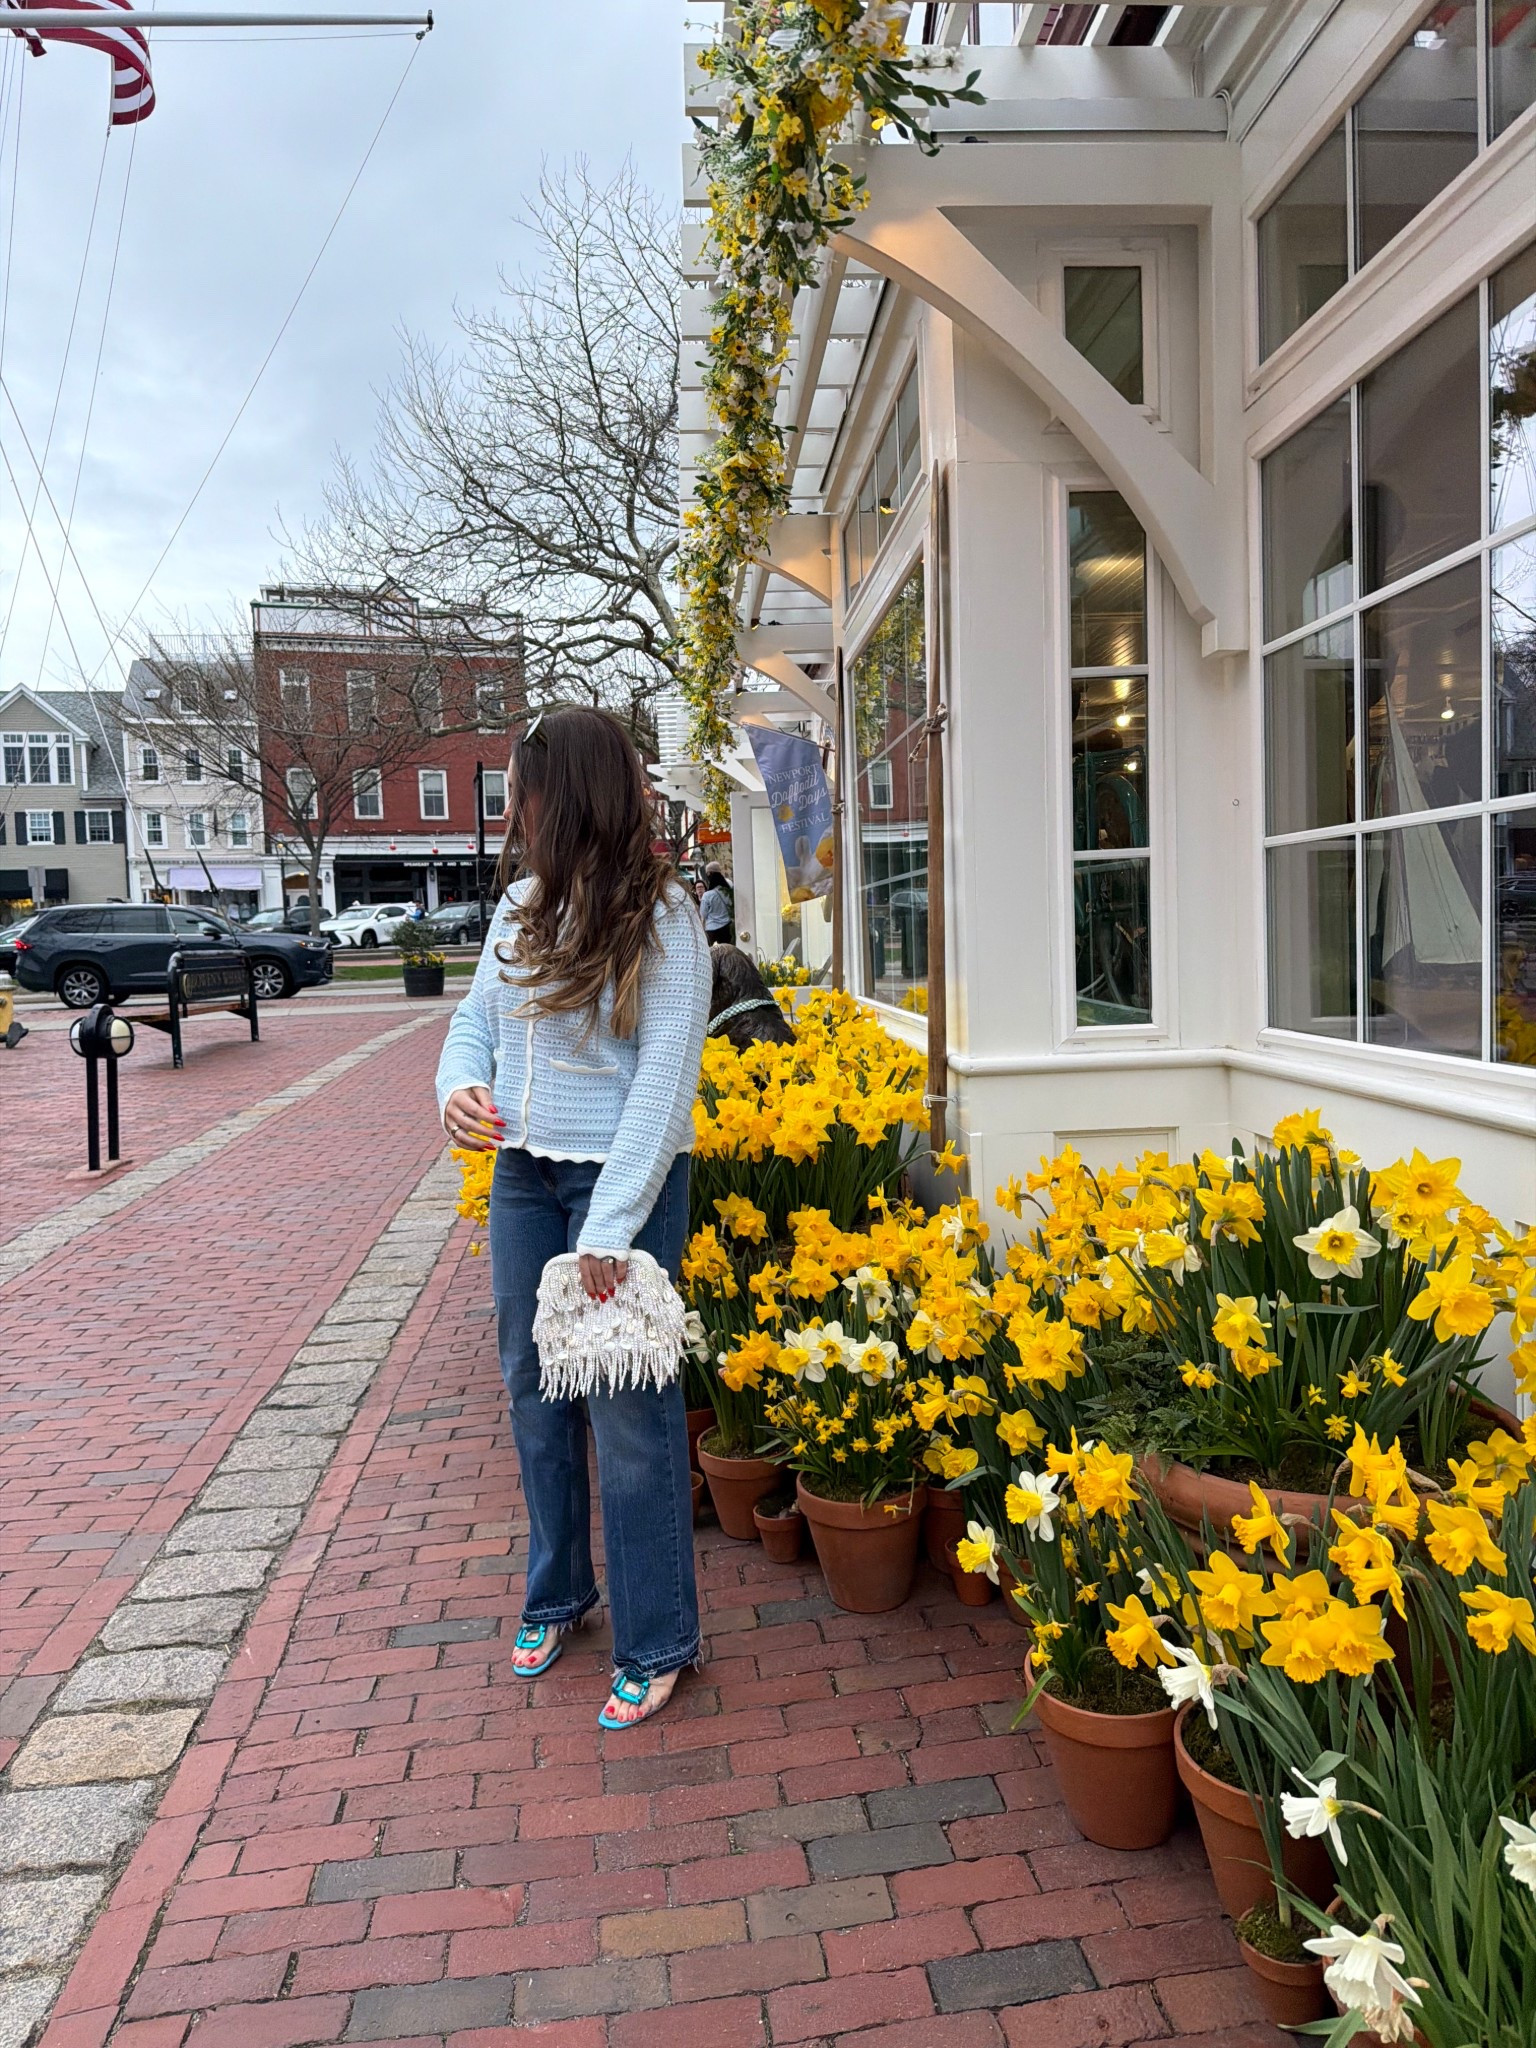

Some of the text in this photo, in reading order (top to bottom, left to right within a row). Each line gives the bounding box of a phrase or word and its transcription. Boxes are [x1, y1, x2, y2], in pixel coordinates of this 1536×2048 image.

[767, 763, 819, 785] NEWPORT
[771, 770, 820, 809] Daffodil
[798, 787, 828, 811] Days
[781, 812, 830, 834] FESTIVAL
